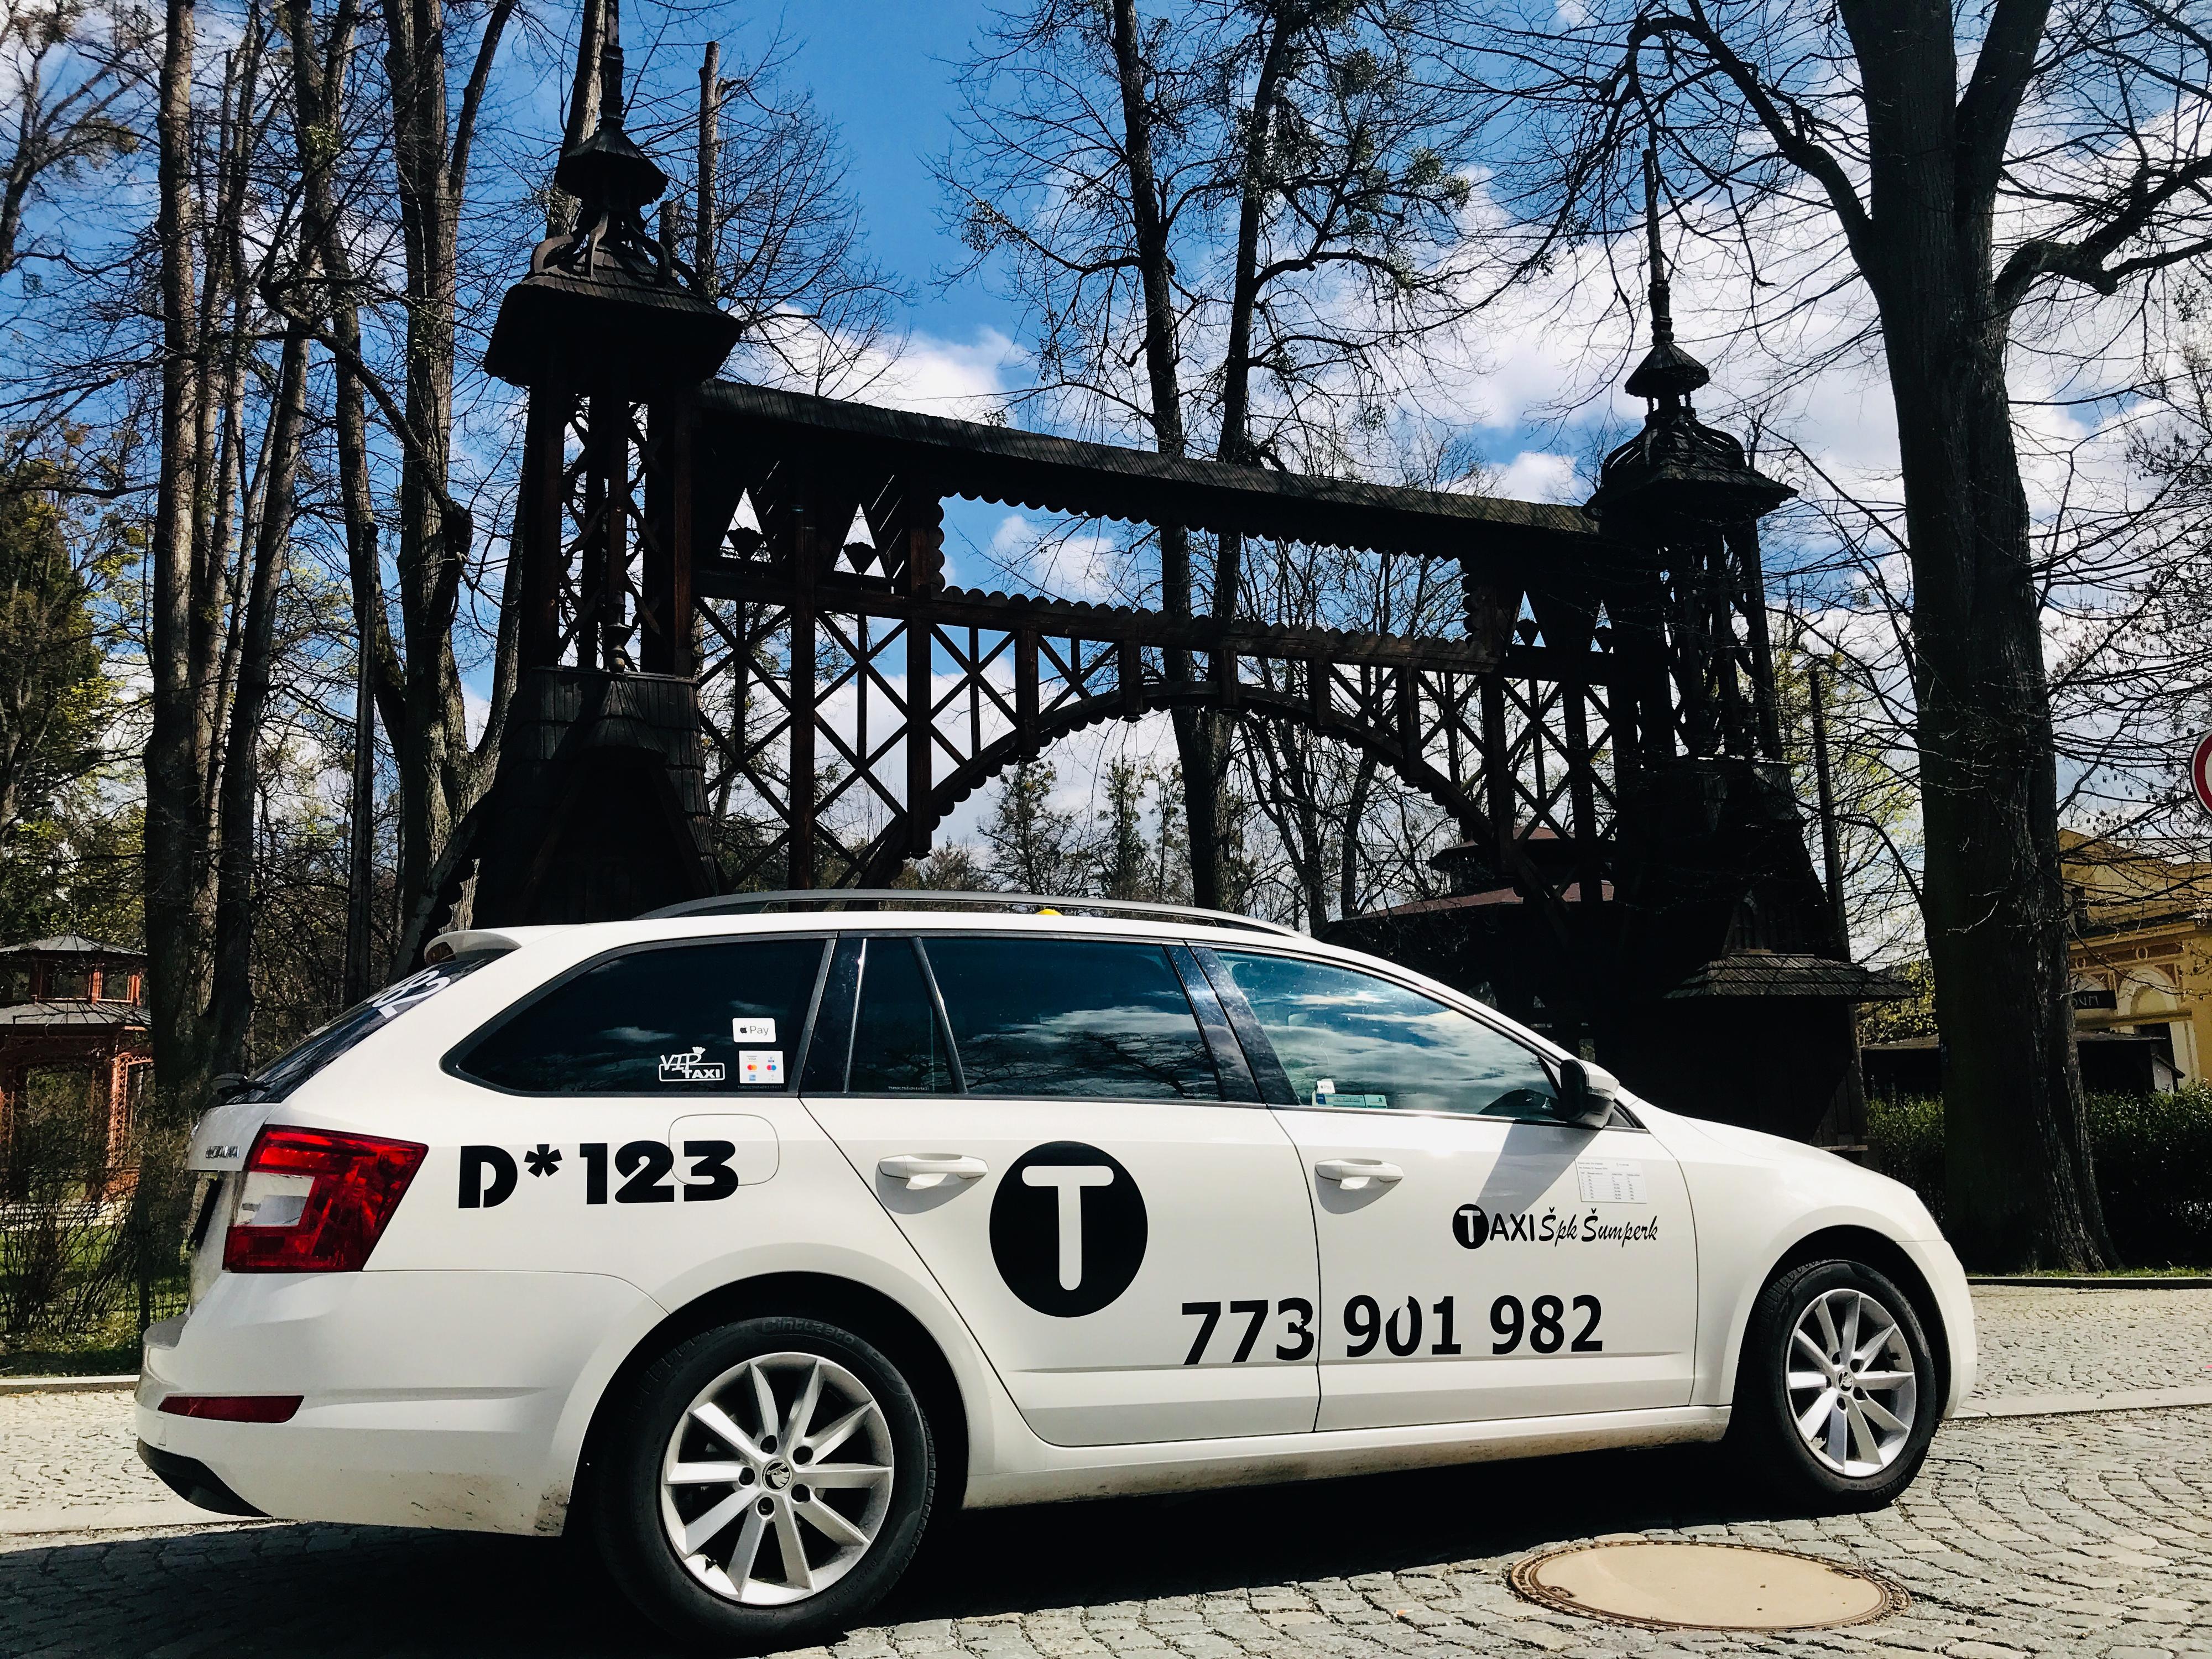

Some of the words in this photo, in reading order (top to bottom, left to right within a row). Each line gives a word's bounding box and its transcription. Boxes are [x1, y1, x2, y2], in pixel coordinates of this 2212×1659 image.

[750, 1025, 769, 1036] Pay
[660, 1052, 702, 1071] VIP
[682, 1068, 721, 1079] TAXI
[580, 1140, 739, 1204] 123
[1021, 1165, 1114, 1291] T
[1459, 1210, 1535, 1243] TAXI
[1538, 1206, 1578, 1248] Špk
[1581, 1207, 1658, 1248] Šumperk
[1182, 1297, 1315, 1366] 773
[1344, 1295, 1462, 1358] 901
[1489, 1295, 1603, 1355] 982
